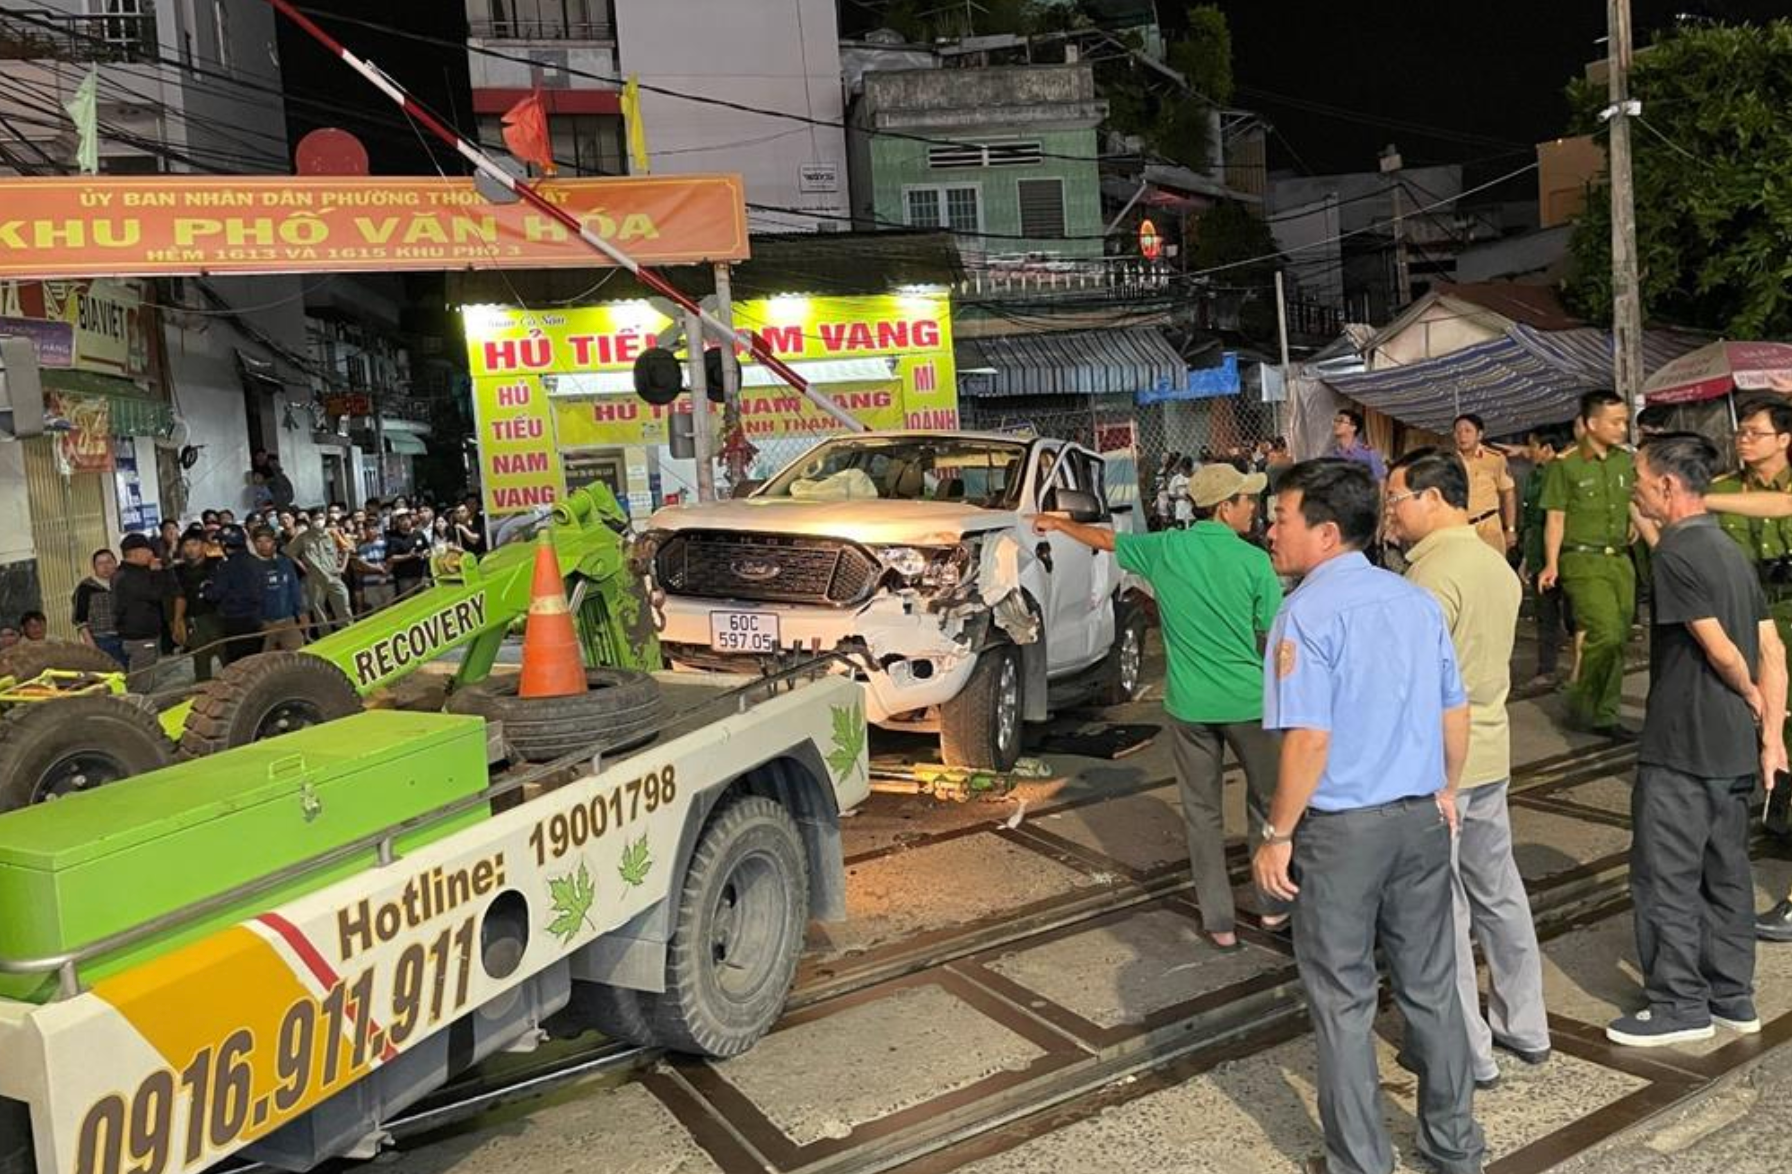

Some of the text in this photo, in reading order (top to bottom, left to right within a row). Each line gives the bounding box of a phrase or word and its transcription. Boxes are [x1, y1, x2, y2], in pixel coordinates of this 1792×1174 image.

[80, 188, 113, 207] ỦY
[123, 192, 176, 206] BAN
[185, 189, 253, 206] NHÂN
[262, 189, 313, 205] DÂN
[322, 188, 420, 206] PHƯỜNG
[175, 207, 337, 246] PHỐ
[353, 212, 497, 243] VĂN
[524, 207, 660, 242] HÓA
[215, 248, 277, 260] 1613
[328, 247, 387, 258] 1615
[396, 246, 445, 258] KHU
[506, 246, 521, 256] 3
[484, 328, 551, 370] HỦ
[569, 324, 659, 365] TIẾ
[820, 319, 940, 352] VANG
[498, 379, 530, 406] HỦ
[594, 398, 638, 421] HỦ
[491, 414, 544, 441] TIẾU
[492, 452, 549, 475] NAM
[492, 486, 556, 508] VANG
[730, 615, 759, 631] 60C
[354, 592, 485, 686] RECOVERY
[719, 631, 772, 650] 597.05
[337, 764, 676, 962] Hotline: 19001798
[76, 916, 476, 1174] 0916.911.911
